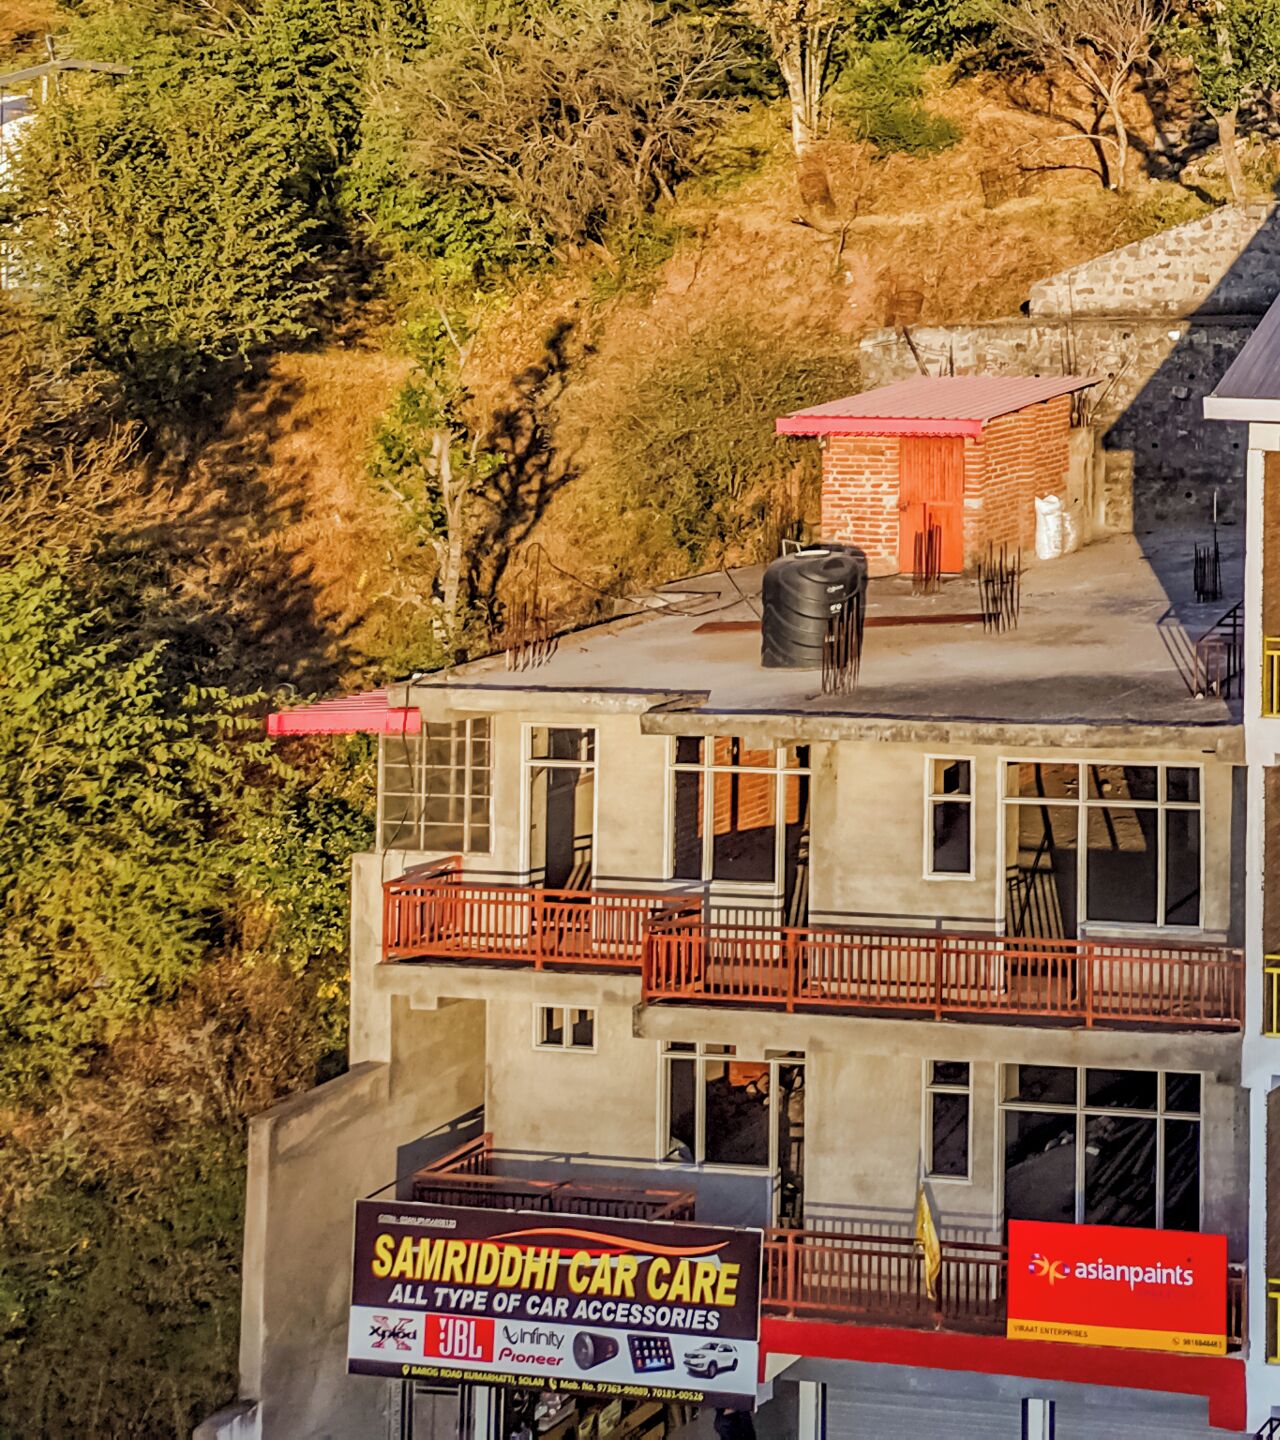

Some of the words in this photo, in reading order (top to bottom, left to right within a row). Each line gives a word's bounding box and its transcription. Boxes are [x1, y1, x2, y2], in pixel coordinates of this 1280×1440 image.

[371, 1233, 561, 1292] SAMRIDDHI
[567, 1250, 639, 1298] CAR
[646, 1256, 742, 1307] CARE
[1074, 1257, 1194, 1291] asianpaints
[388, 1283, 429, 1306] ALL
[434, 1287, 488, 1312] TYPE
[491, 1290, 521, 1313] OF
[525, 1295, 569, 1319] CAR
[572, 1298, 721, 1332] ACCESSORIES
[438, 1317, 483, 1359] JBL
[517, 1325, 566, 1351] Infinity
[497, 1347, 565, 1368] Pioneer
[440, 1369, 463, 1379] ROAD
[518, 1375, 545, 1387] SOLAN
[582, 1382, 596, 1392] No.
